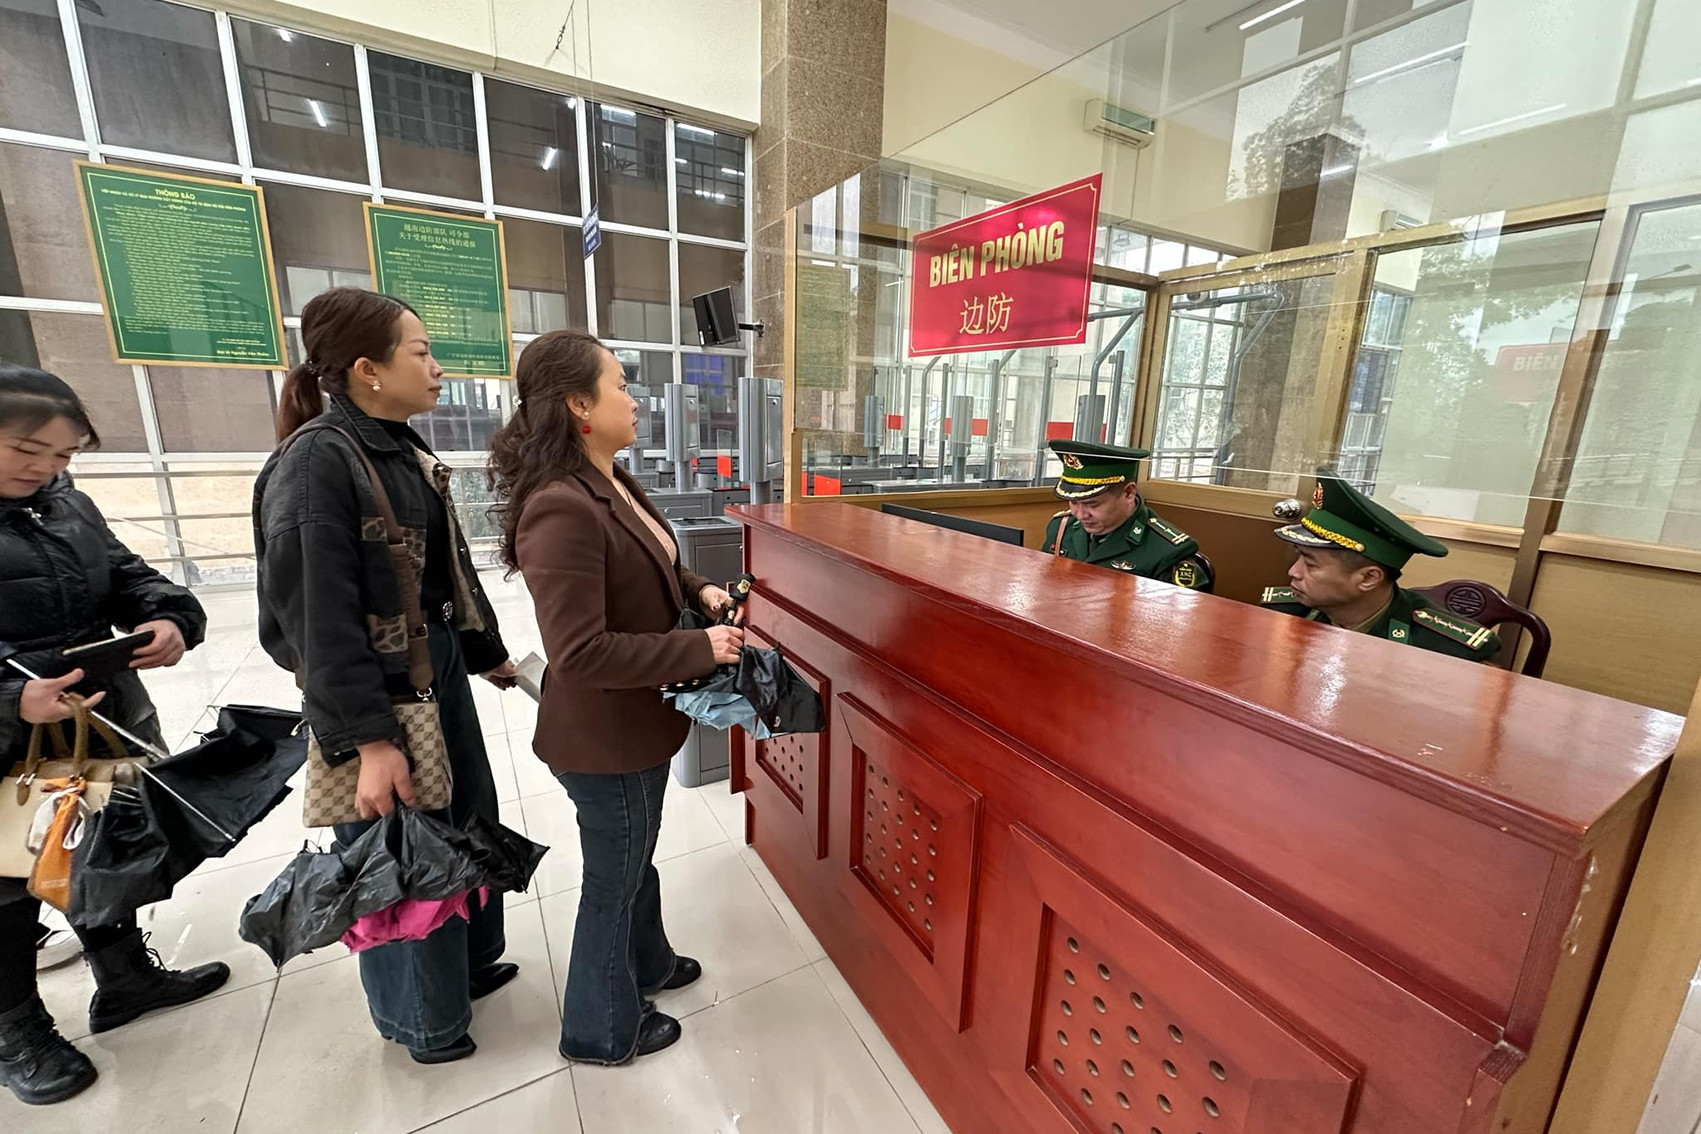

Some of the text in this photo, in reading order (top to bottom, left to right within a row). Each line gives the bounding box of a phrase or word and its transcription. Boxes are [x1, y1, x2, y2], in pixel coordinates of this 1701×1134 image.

[155, 188, 196, 200] THÔNG BÁO
[929, 221, 1065, 288] BIÊN PHÒNG
[959, 292, 1014, 335] 边防
